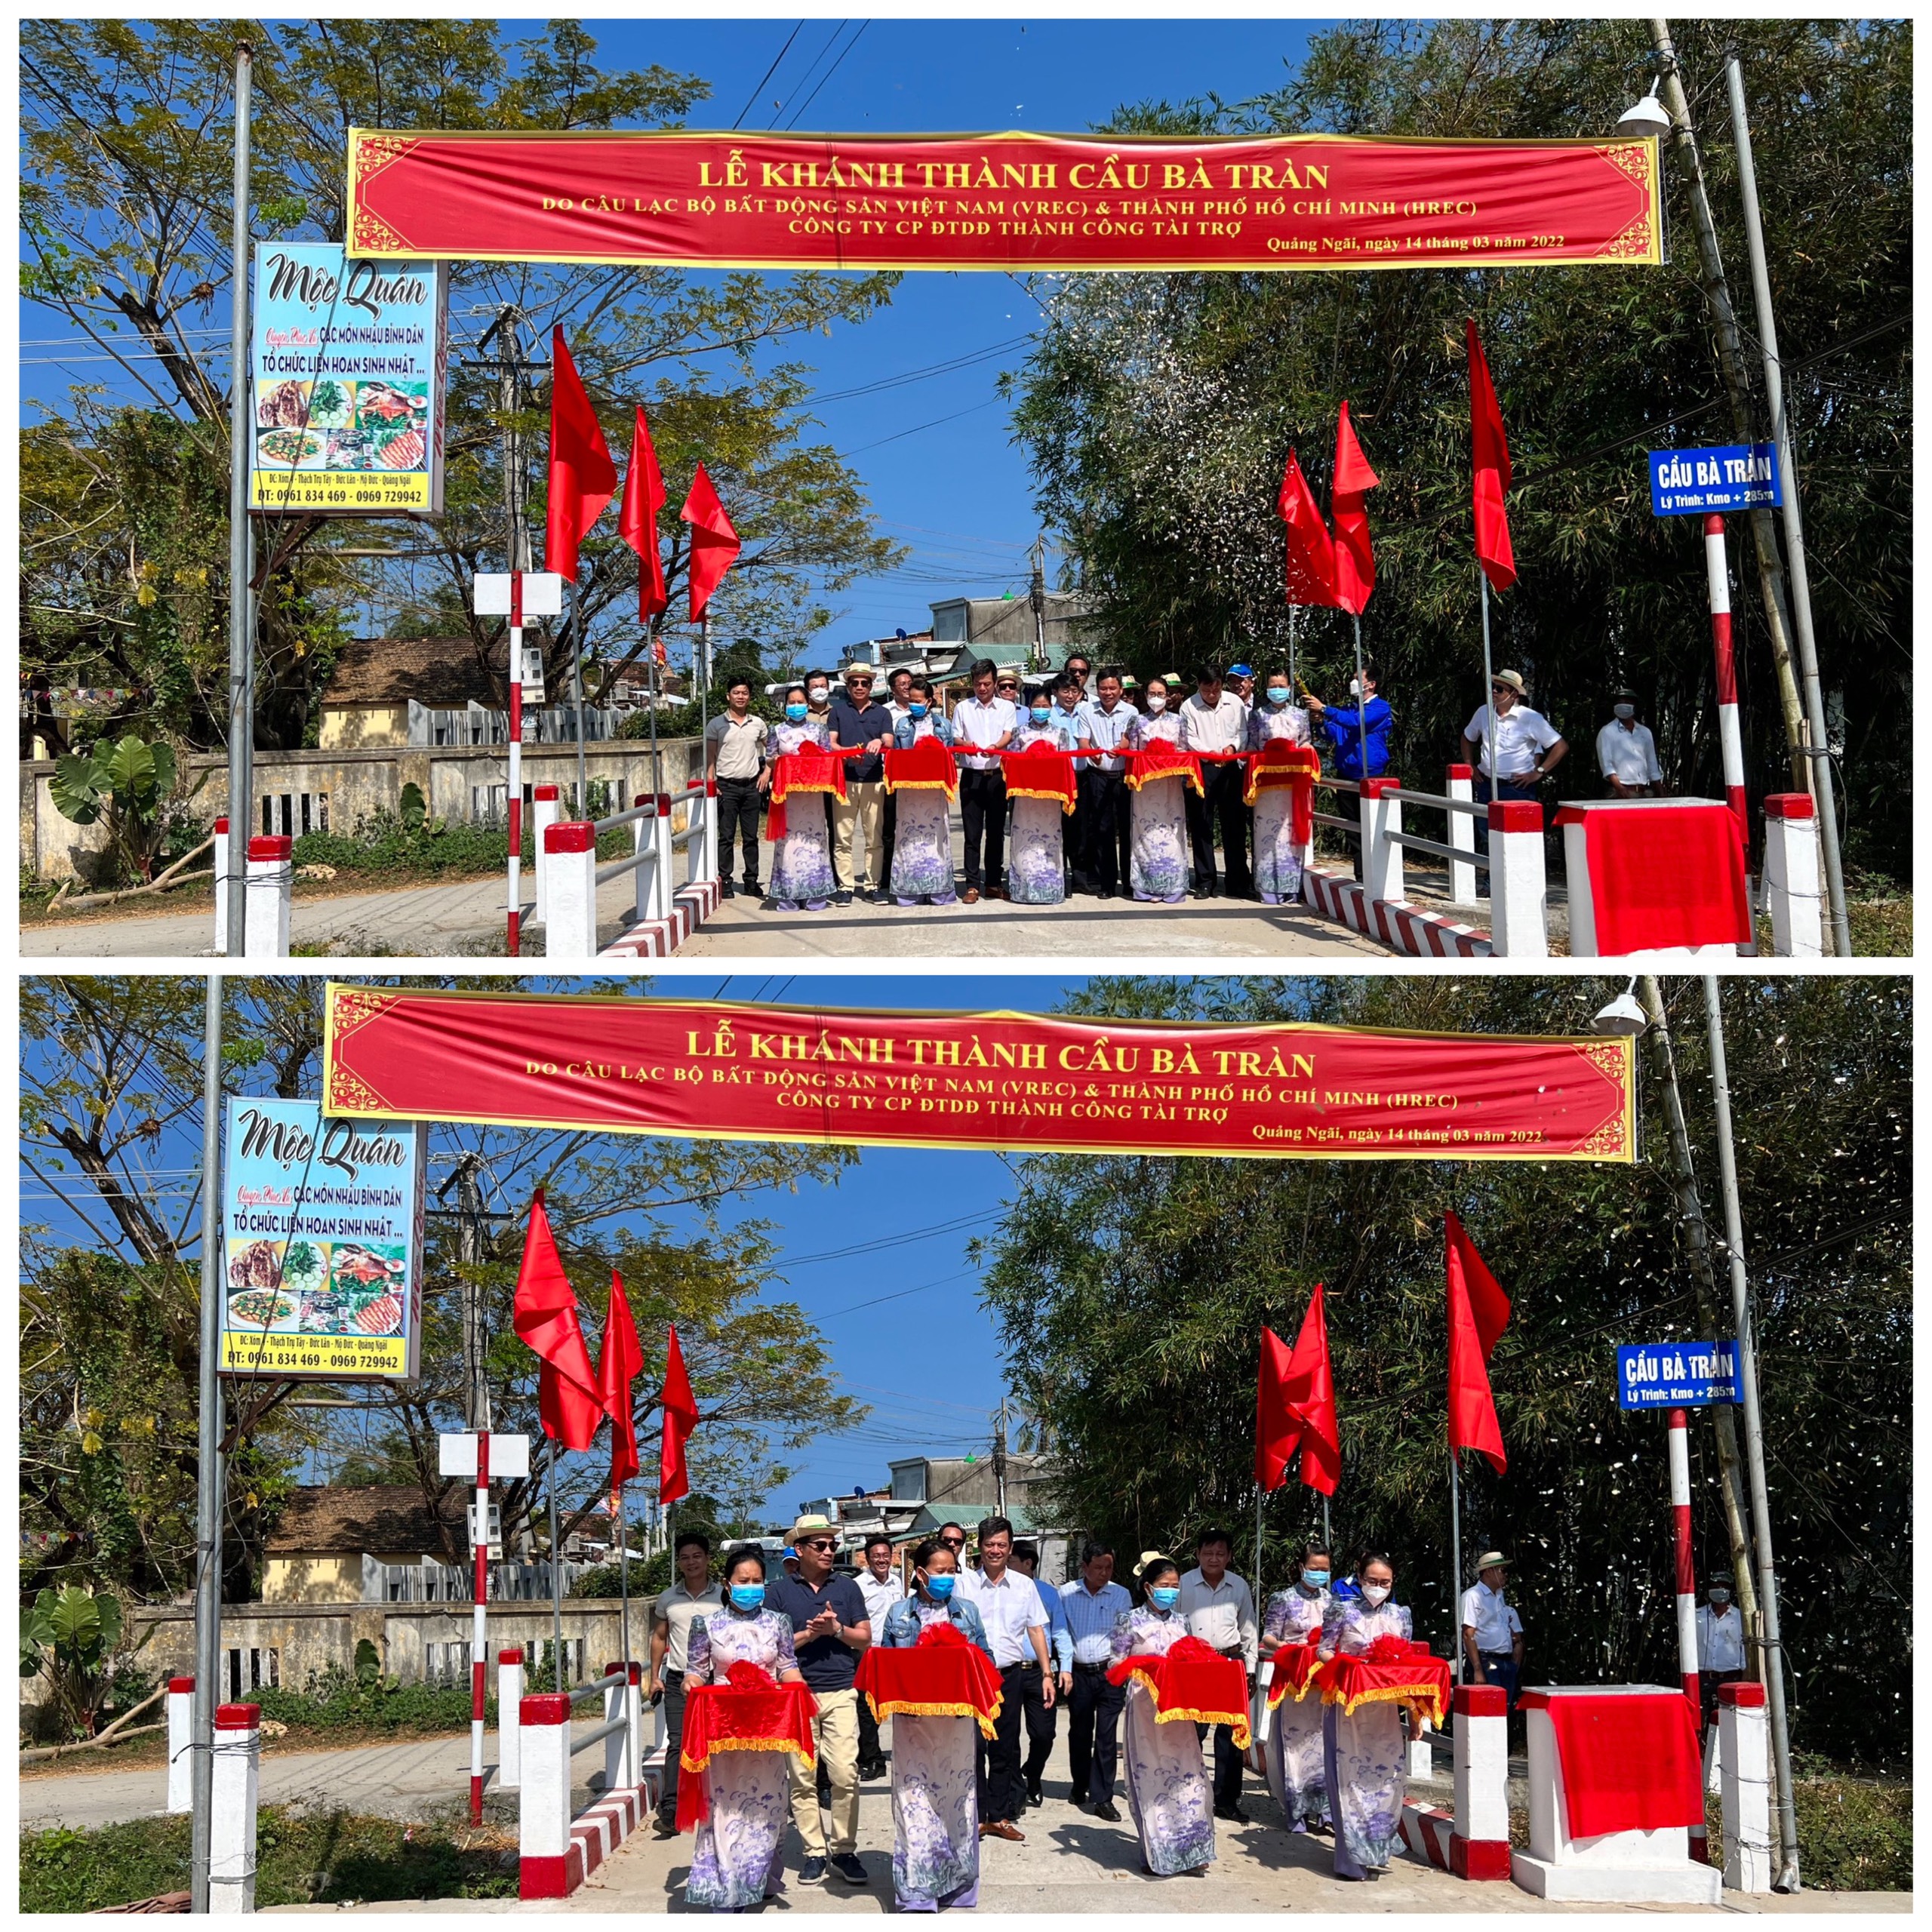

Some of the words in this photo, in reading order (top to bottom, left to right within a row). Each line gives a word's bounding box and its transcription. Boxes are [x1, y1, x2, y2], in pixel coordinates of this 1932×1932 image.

[699, 149, 749, 186] LỄ
[761, 156, 905, 188] KHÁNH
[915, 157, 1057, 188] THÀNH
[1068, 154, 1151, 189] CẦU
[1161, 158, 1214, 189] BÀ
[1223, 158, 1329, 189] TRÀN
[543, 198, 573, 211] DO
[582, 195, 626, 212] CÂU
[635, 199, 677, 214] LẠC
[688, 196, 715, 215] BỘ
[725, 195, 765, 212] BẤT
[776, 197, 837, 215] ĐỘNG
[847, 198, 886, 213] SẢN
[897, 197, 947, 217] VIỆT
[957, 202, 1004, 214] NAM
[1013, 202, 1088, 217] (VREC)
[1096, 202, 1110, 214] &
[1121, 200, 1194, 214] THÀNH
[1204, 197, 1247, 214] PHỐ
[1256, 197, 1285, 214] HỒ
[1294, 200, 1331, 214] CHÍ
[1340, 202, 1395, 214] MINH
[1404, 202, 1476, 216] (HREC)
[789, 219, 851, 233] CÔNG
[861, 221, 886, 233] TY
[896, 221, 923, 234] CP
[932, 222, 990, 234] ĐTDĐ
[999, 220, 1073, 235] THÀNH
[1083, 220, 1143, 235] CÔNG
[1152, 220, 1187, 235] TÀI
[1198, 221, 1241, 238] TRỢ
[1267, 238, 1317, 252] Quảng
[1323, 238, 1360, 252] Ngãi,
[1365, 238, 1398, 252] ngày
[1407, 238, 1422, 248] 14
[1427, 238, 1468, 250] tháng
[1473, 236, 1490, 248] 03
[1495, 237, 1525, 247] năm
[1533, 235, 1564, 247] 2022
[266, 253, 340, 312] Mộc
[342, 259, 427, 319] Quán
[339, 322, 358, 343] MÓN
[360, 323, 383, 348] NHẬU
[385, 322, 405, 343] BÌNH
[407, 323, 423, 343] DÂN
[263, 346, 275, 372] TỔ
[278, 351, 306, 372] CHỨC
[332, 356, 360, 373] HOAN
[362, 357, 385, 374] SINH
[388, 352, 414, 379] NHẬT
[1658, 455, 1692, 488] CẦU
[1697, 456, 1721, 486] BÀ
[1724, 453, 1771, 484] TRÀN
[277, 490, 301, 501] 0961
[305, 490, 324, 501] 834
[328, 491, 346, 502] 469
[356, 491, 381, 502] 0969
[385, 491, 421, 502] 729942
[687, 1020, 737, 1057] LỄ
[749, 1029, 894, 1063] KHÁNH
[906, 1035, 1047, 1069] THÀNH
[1057, 1036, 1140, 1072] CẦU
[1150, 1043, 1201, 1074] BÀ
[1211, 1046, 1315, 1078] TRÀN
[527, 1062, 558, 1075] DO
[567, 1062, 611, 1078] CÂU
[621, 1065, 665, 1082] LẠC
[675, 1066, 703, 1084] BỘ
[713, 1066, 755, 1084] BẤT
[764, 1069, 826, 1088] ĐỘNG
[835, 1072, 875, 1088] SẢN
[886, 1074, 937, 1094] VIỆT
[946, 1078, 993, 1093] NAM
[1002, 1081, 1076, 1097] (VREC)
[1084, 1084, 1099, 1098] &
[1109, 1084, 1182, 1099] THÀNH
[1192, 1084, 1233, 1100] PHỐ
[1242, 1084, 1272, 1102] HỒ
[1279, 1088, 1315, 1104] CHÍ
[1324, 1092, 1379, 1106] MINH
[1387, 1094, 1457, 1109] (HREC)
[777, 1091, 839, 1107] CÔNG
[850, 1096, 875, 1109] TY
[884, 1097, 912, 1110] CP
[921, 1099, 979, 1113] ĐTDĐ
[988, 1099, 1062, 1116] THÀNH
[1071, 1100, 1131, 1118] CÔNG
[1141, 1103, 1175, 1119] TÀI
[1185, 1108, 1228, 1123] TRỢ
[238, 1109, 315, 1170] Mộc
[318, 1119, 407, 1181] Quán
[1253, 1126, 1301, 1140] Quảng
[1308, 1127, 1343, 1141] Ngãi,
[1349, 1129, 1381, 1143] ngày
[1389, 1129, 1404, 1140] 14
[1408, 1130, 1449, 1143] tháng
[1454, 1130, 1469, 1140] 03
[1475, 1131, 1504, 1141] năm
[1511, 1131, 1541, 1142] 2022
[313, 1182, 334, 1204] MÓN
[336, 1183, 360, 1211] NHẬU
[362, 1184, 381, 1205] BÌNH
[384, 1185, 401, 1207] DÂN
[234, 1204, 247, 1230] TỔ
[250, 1210, 278, 1232] CHỨC
[306, 1217, 336, 1234] HOAN
[338, 1218, 361, 1235] SINH
[365, 1215, 392, 1241] NHẬT
[248, 1352, 273, 1364] 0961
[278, 1353, 297, 1364] 834
[300, 1354, 319, 1366] 469
[331, 1355, 357, 1367] 0969
[360, 1355, 398, 1367] 729942
[1626, 1350, 1658, 1383] CẦU
[1663, 1352, 1685, 1381] BÀ
[1688, 1349, 1734, 1380] TRÀN
